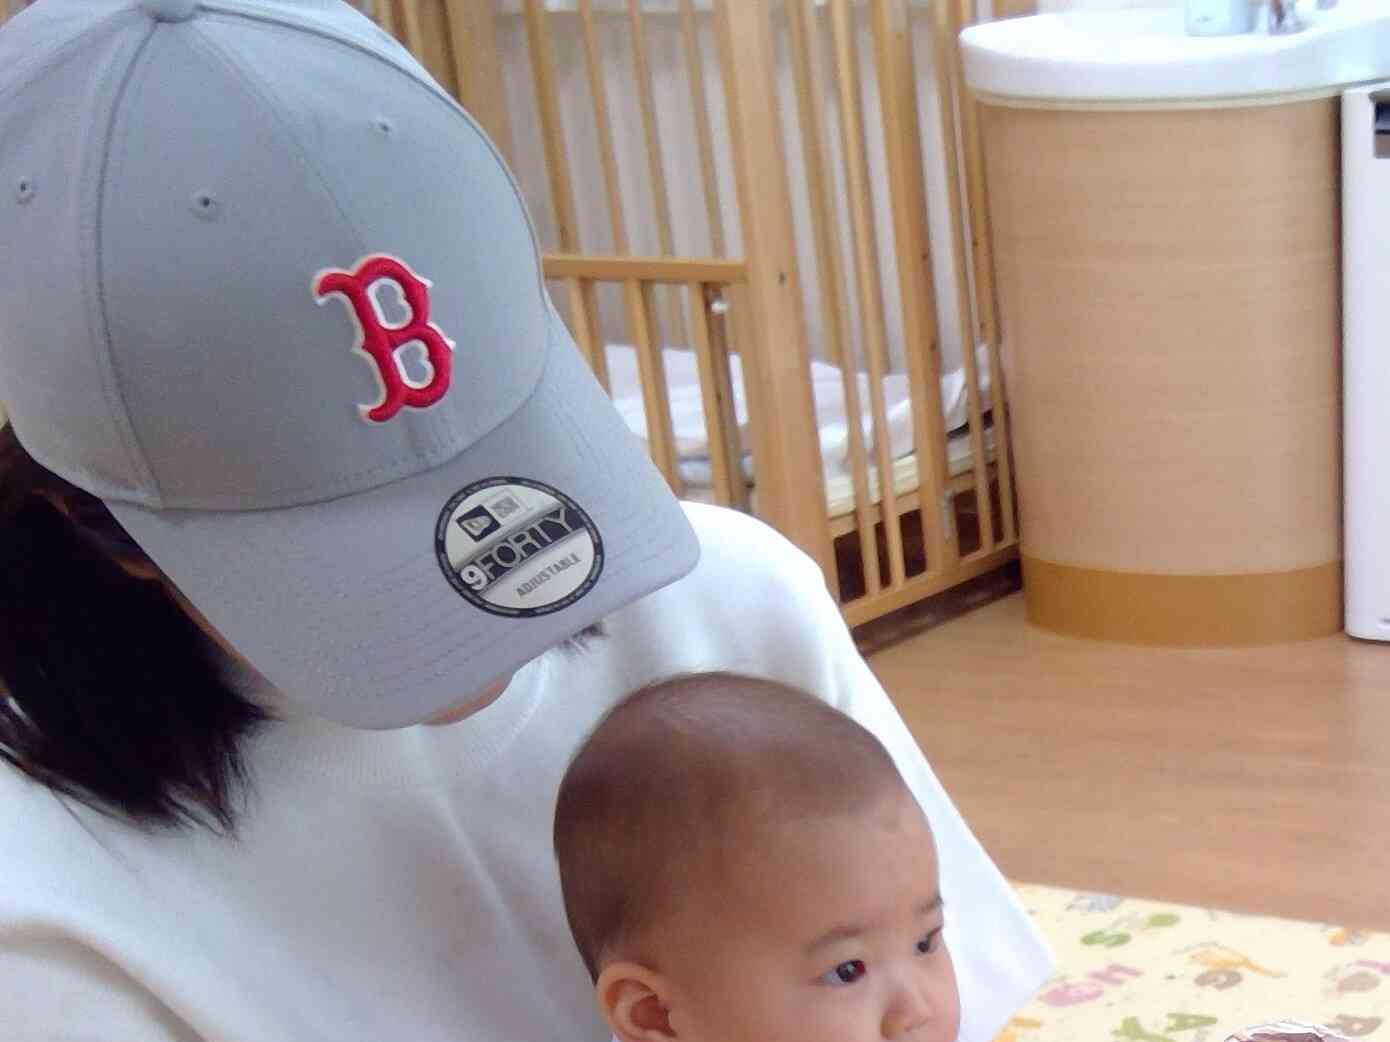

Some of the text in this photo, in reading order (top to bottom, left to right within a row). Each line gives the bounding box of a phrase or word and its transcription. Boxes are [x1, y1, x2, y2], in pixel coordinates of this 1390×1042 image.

[311, 252, 457, 424] B
[460, 506, 575, 592] 9FORTY
[516, 551, 583, 597] ADJUSTABLE
